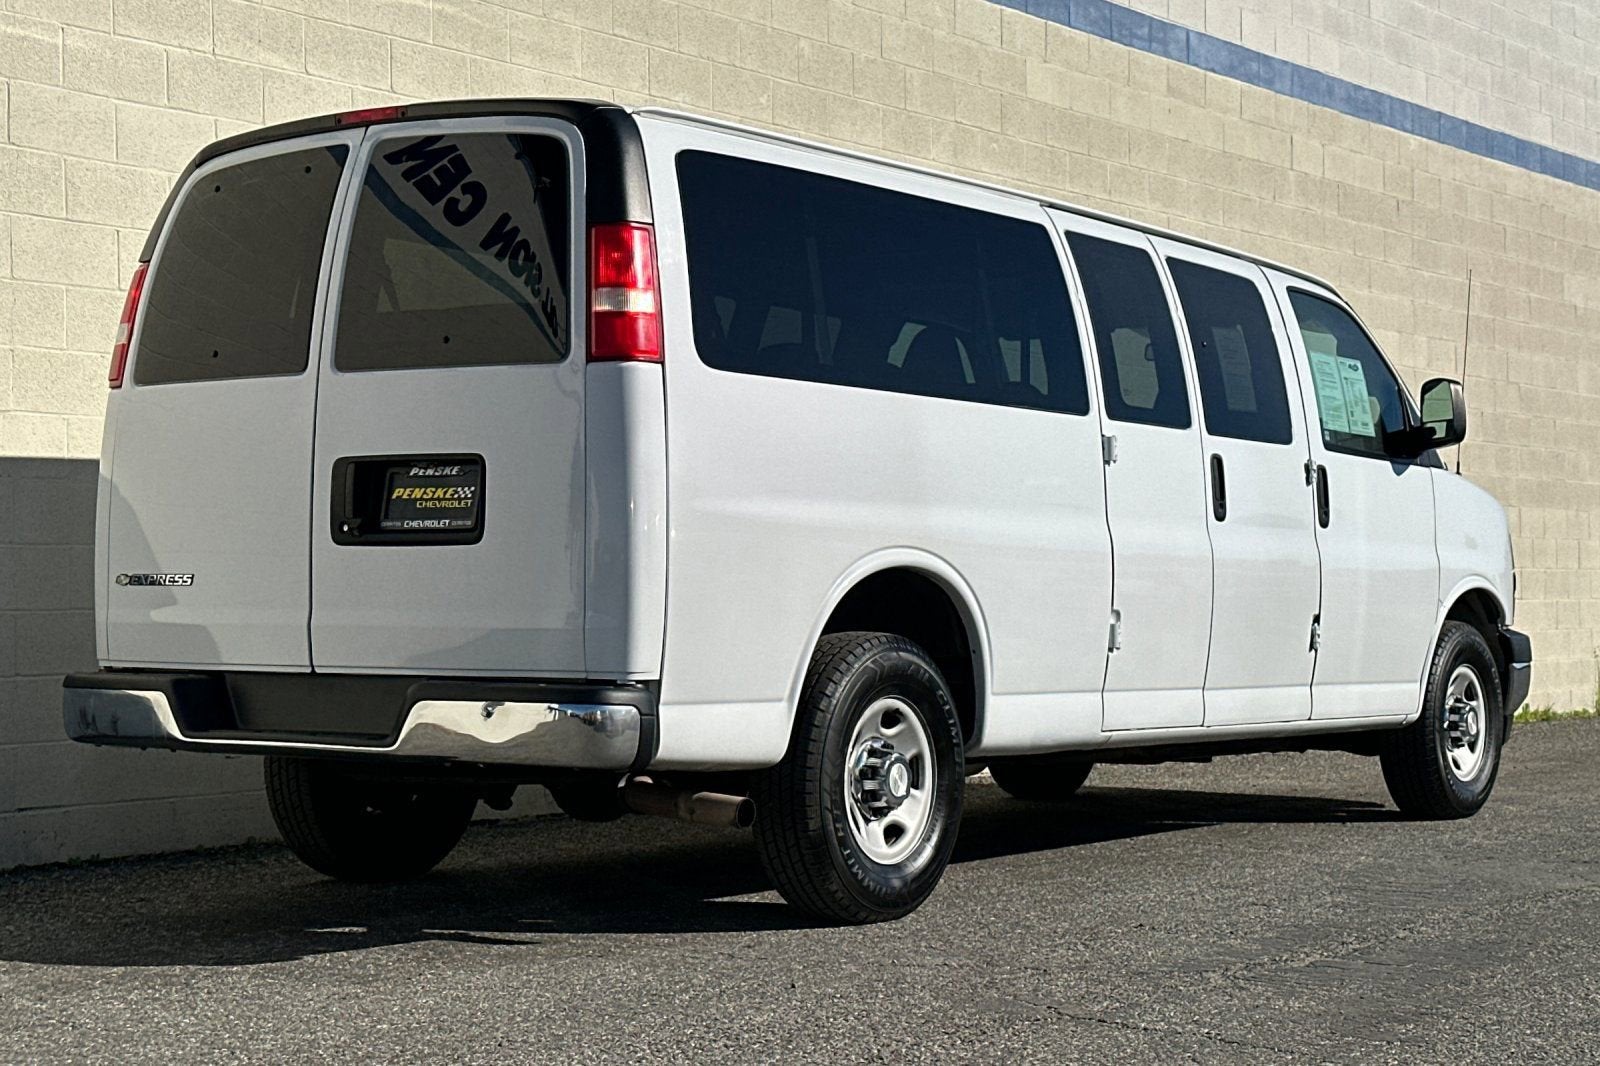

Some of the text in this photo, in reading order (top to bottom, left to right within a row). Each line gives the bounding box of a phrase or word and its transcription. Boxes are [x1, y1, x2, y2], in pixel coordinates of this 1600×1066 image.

[409, 465, 461, 476] PENSKE
[391, 487, 458, 499] PENSKE
[416, 499, 473, 508] CHEVROLET
[403, 519, 451, 528] CHEVROLET
[131, 574, 194, 586] EXPRESS
